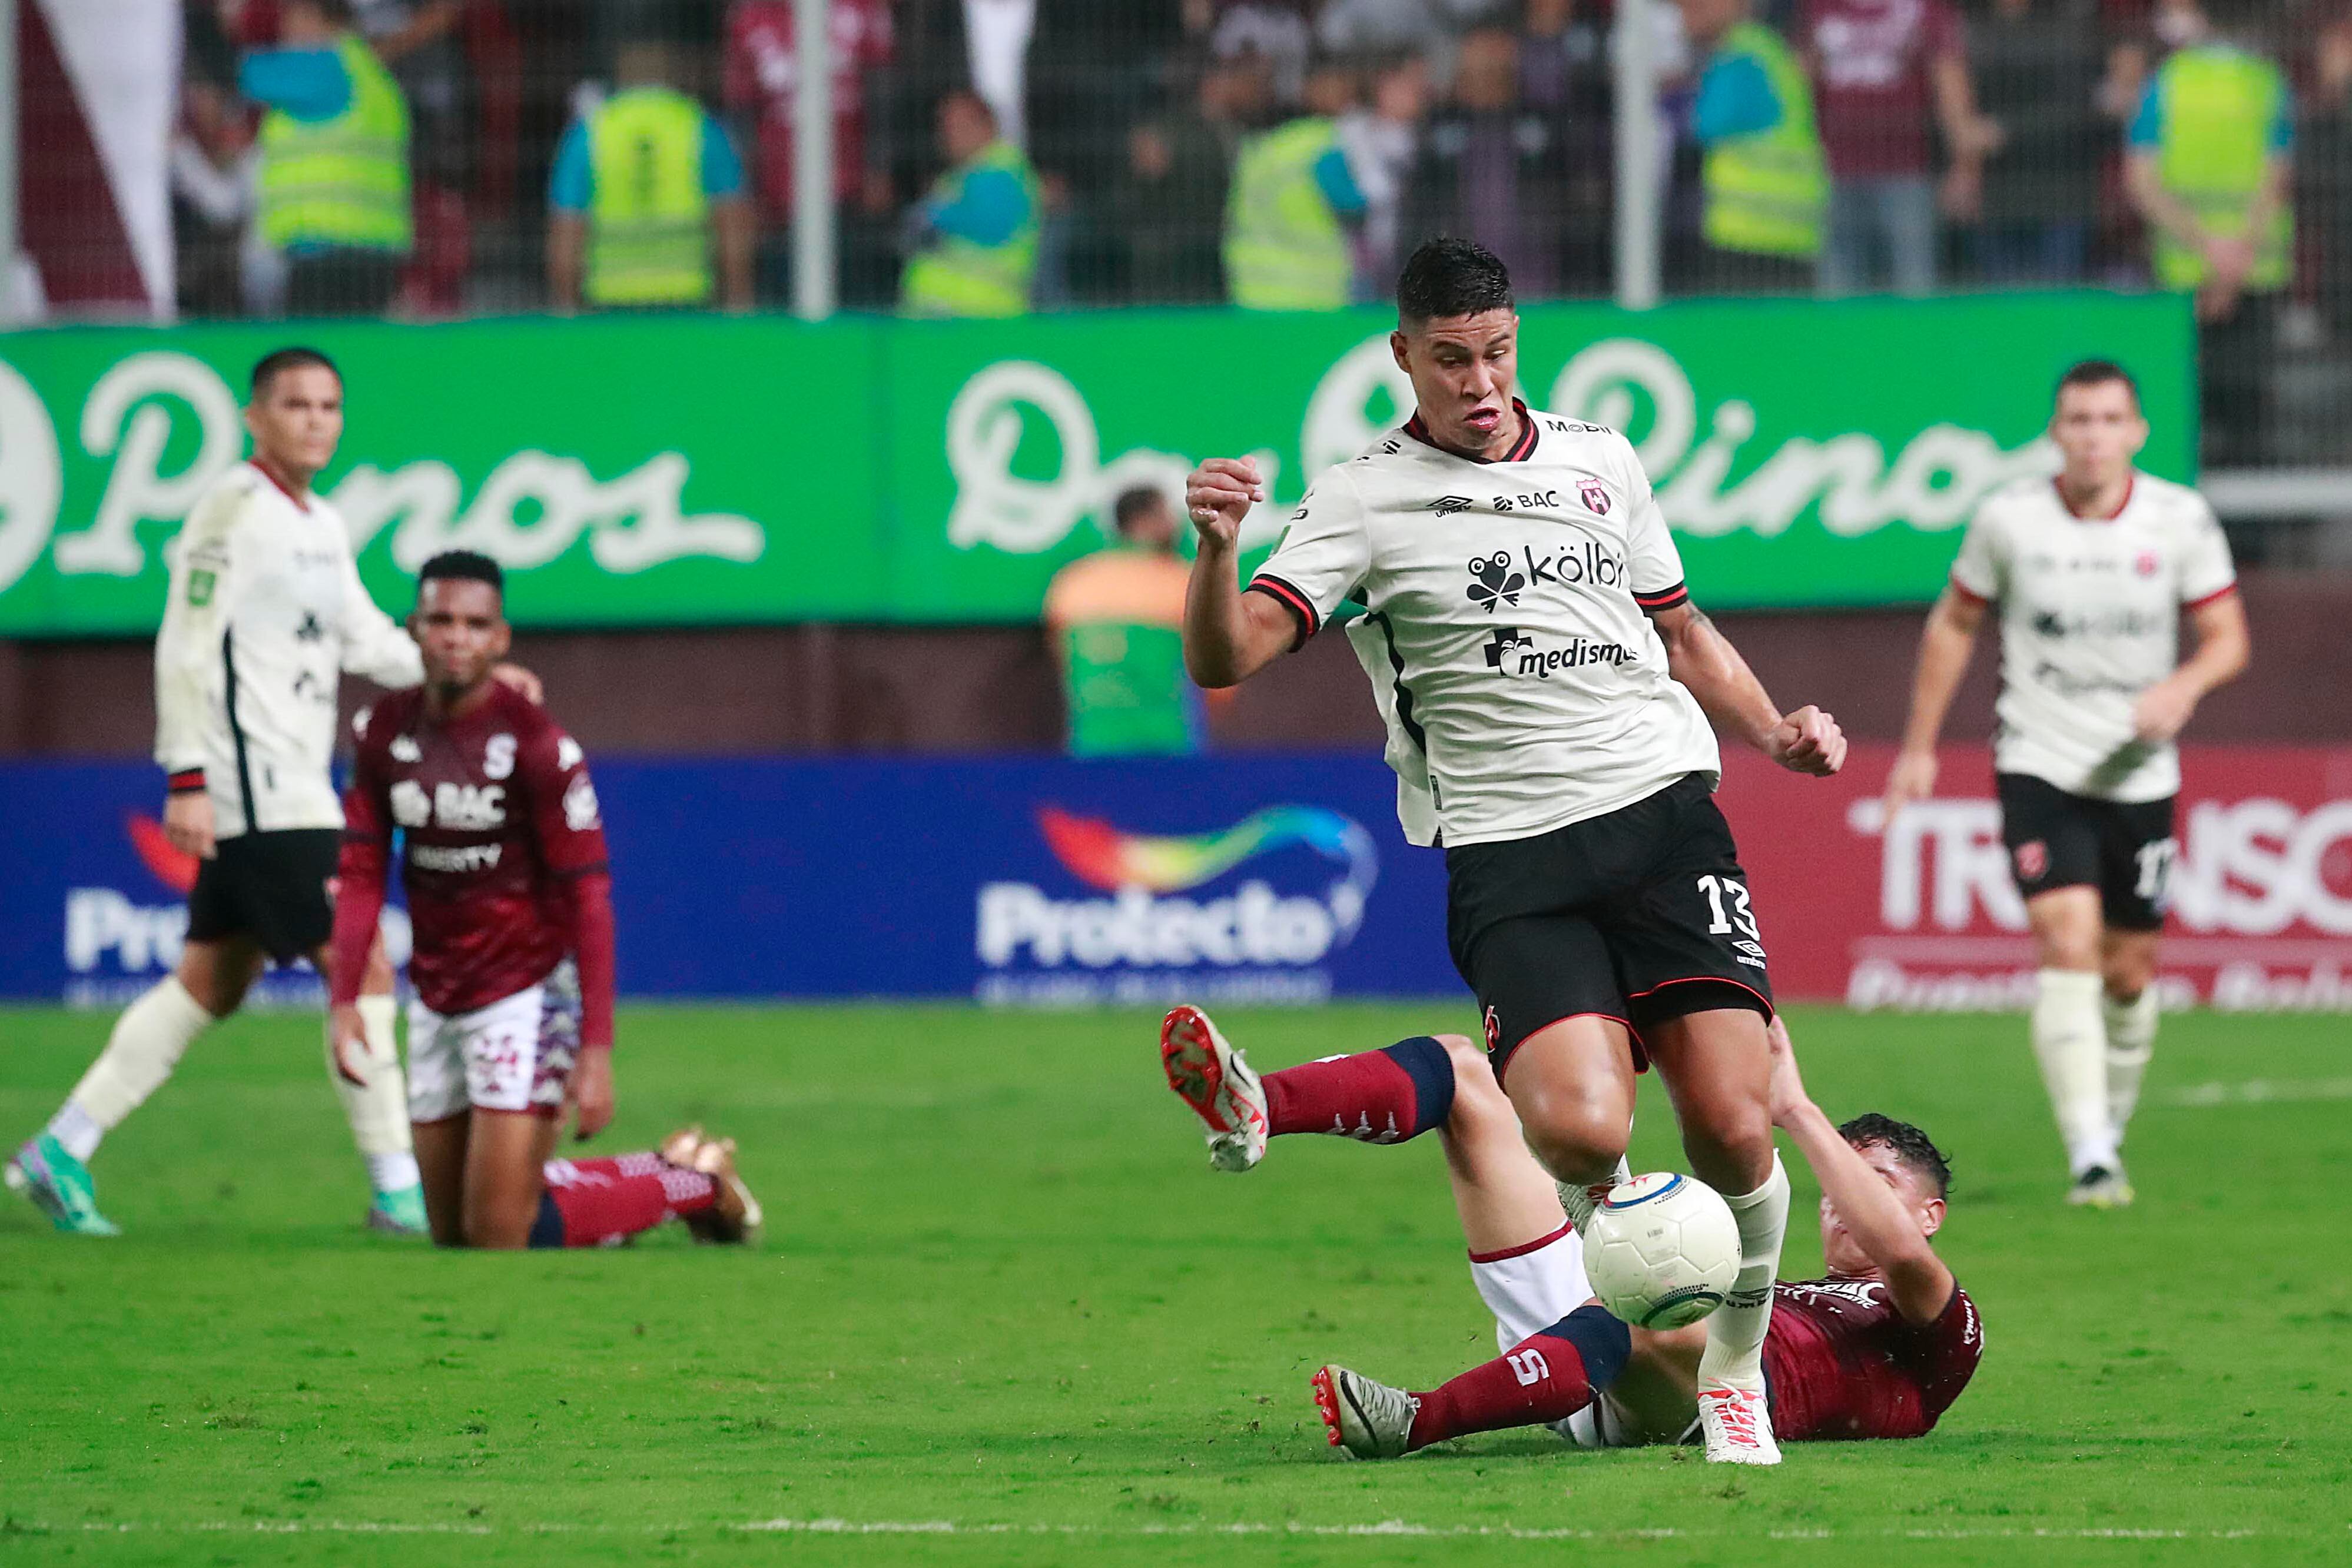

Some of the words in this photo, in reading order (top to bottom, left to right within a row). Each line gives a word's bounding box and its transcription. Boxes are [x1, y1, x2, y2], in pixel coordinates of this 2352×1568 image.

[1545, 420, 1613, 435] Mobil
[55, 350, 765, 574] Pnos
[1517, 490, 1560, 508] BAC
[976, 882, 1335, 968] Protecto
[1697, 875, 1761, 942] 13
